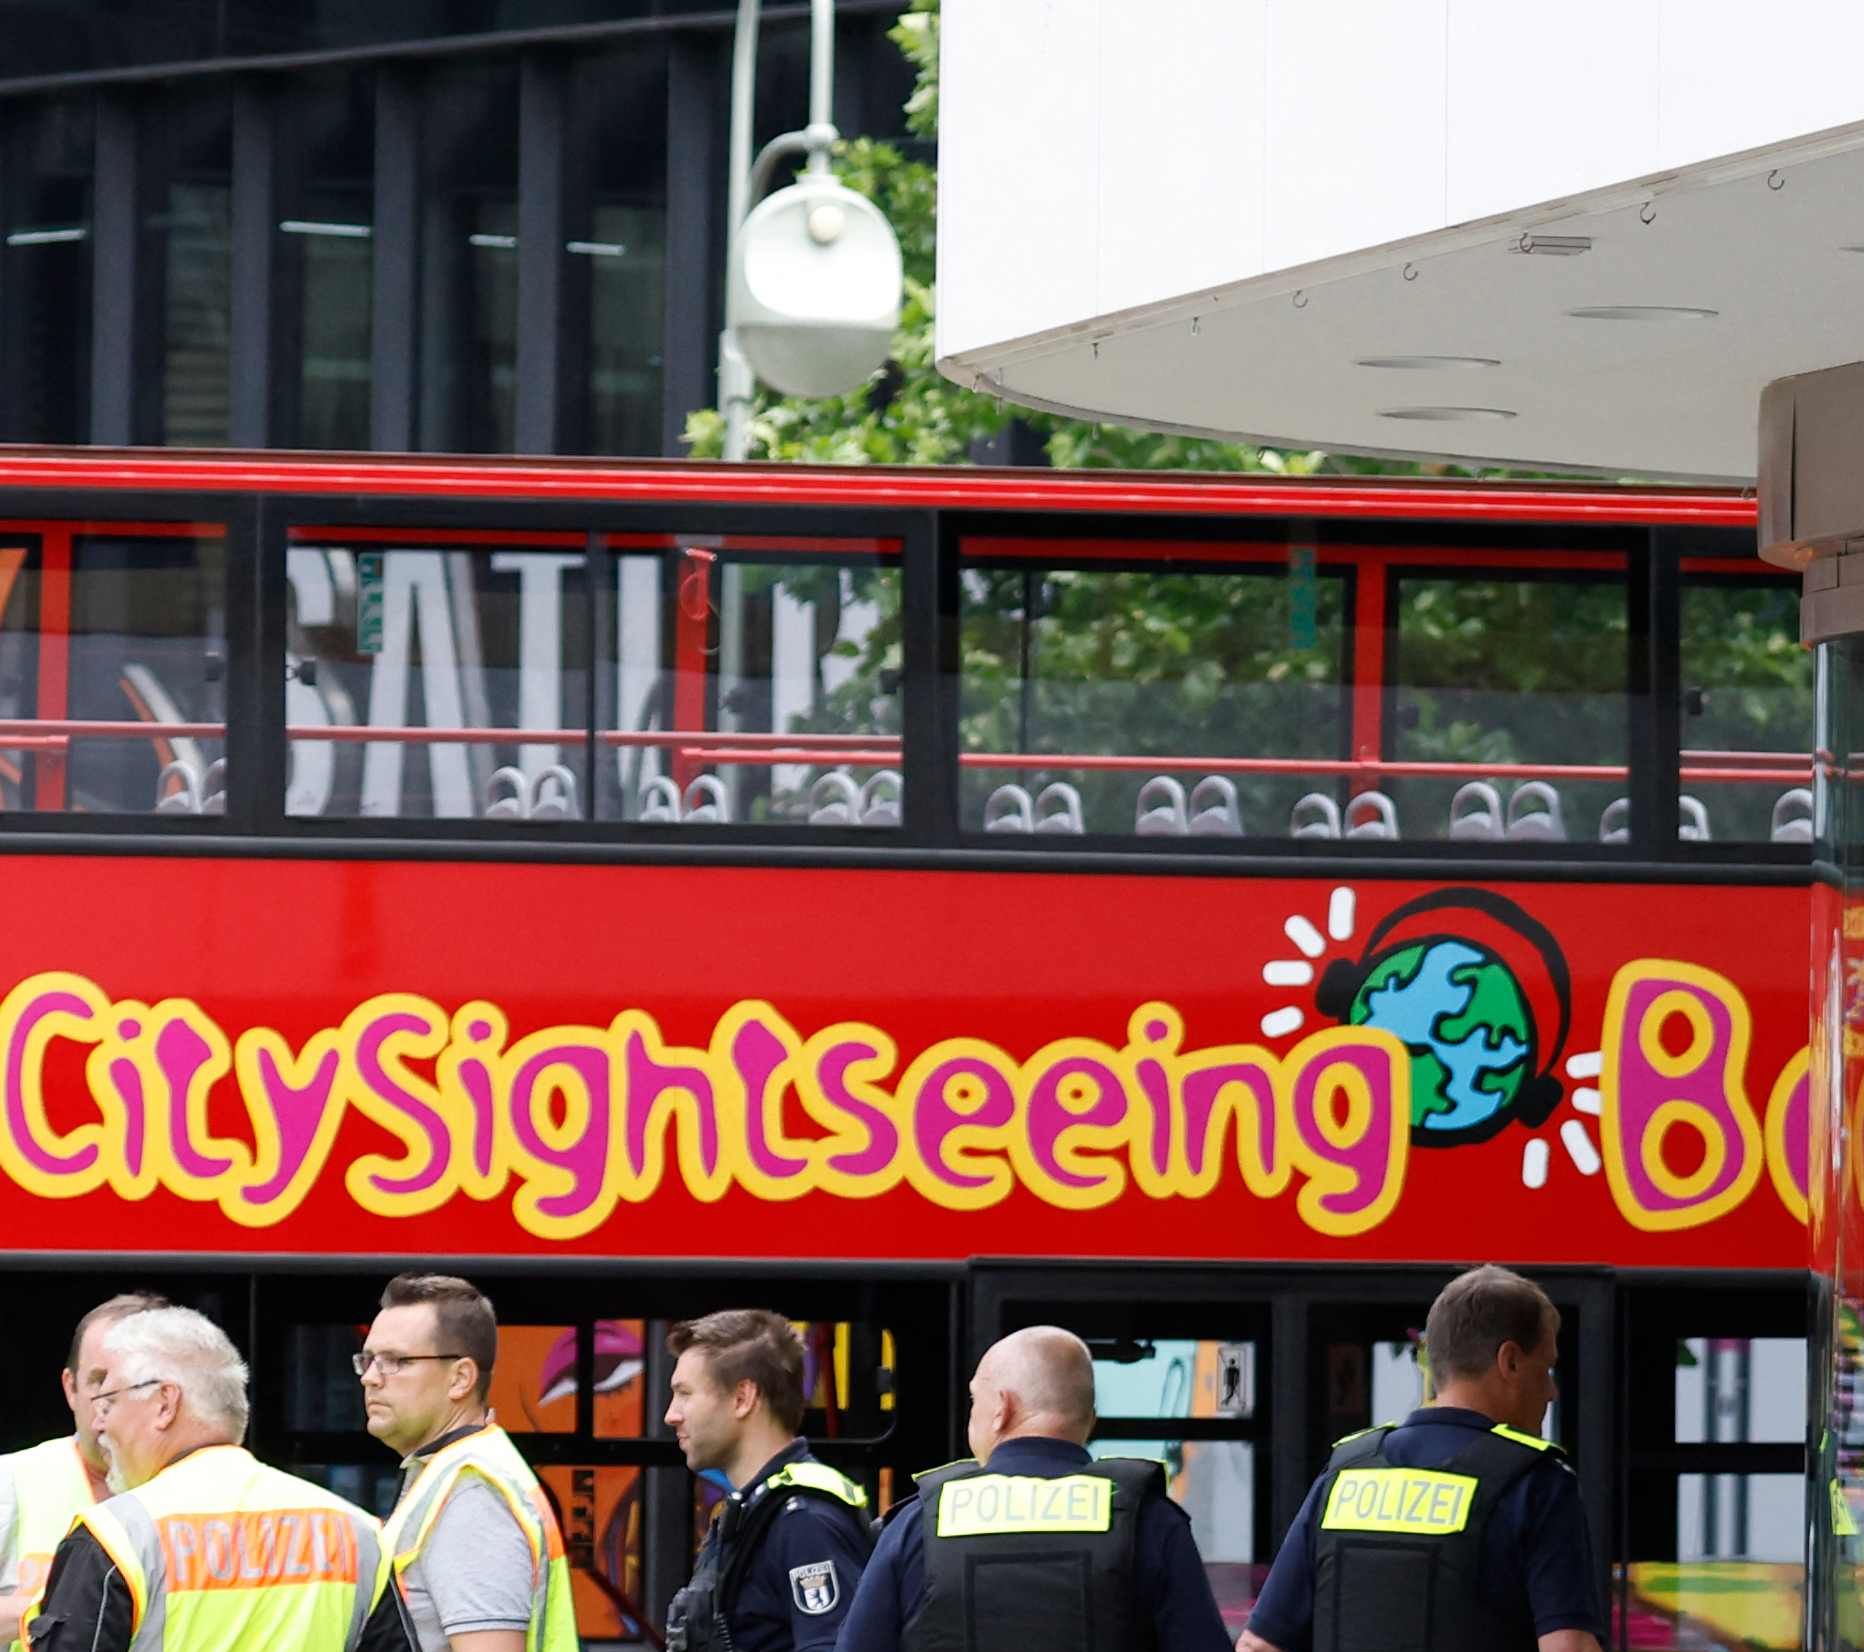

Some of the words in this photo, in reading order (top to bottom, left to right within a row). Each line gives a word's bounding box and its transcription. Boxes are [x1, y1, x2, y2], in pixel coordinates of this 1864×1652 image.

[0, 972, 1412, 1241] CitySightseeing
[950, 1481, 1103, 1525] POLIZEI
[1332, 1475, 1470, 1527] POLIZEI
[168, 1513, 354, 1582] POLIZEI
